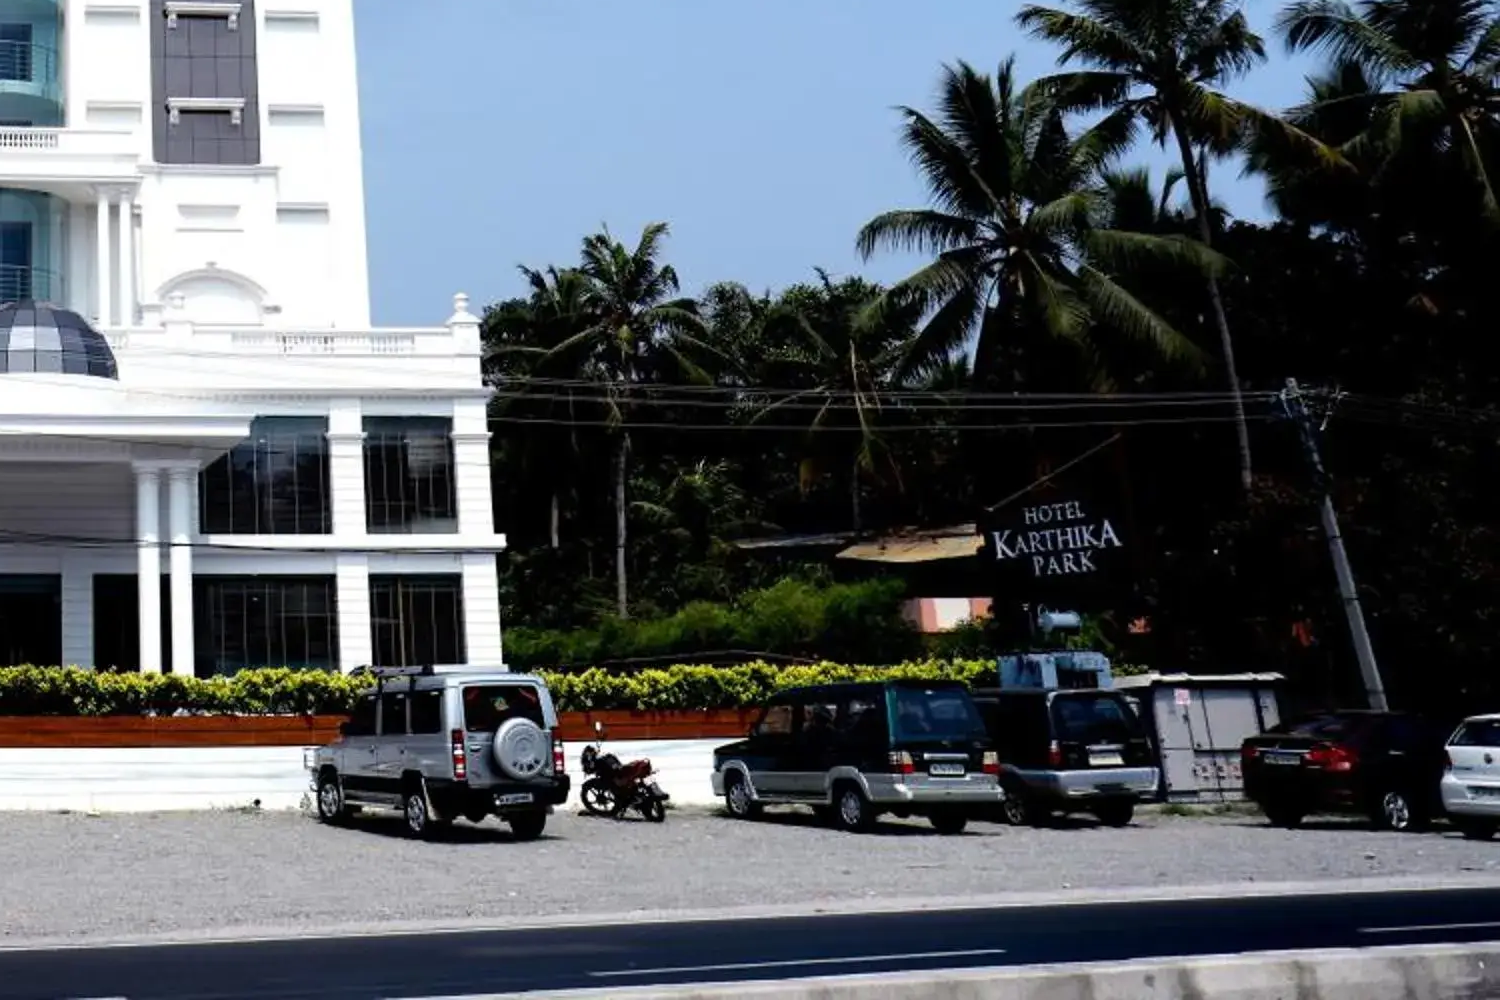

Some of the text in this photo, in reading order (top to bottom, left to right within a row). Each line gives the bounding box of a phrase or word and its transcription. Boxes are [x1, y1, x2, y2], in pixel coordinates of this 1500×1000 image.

[1022, 501, 1086, 525] HOTEL
[991, 519, 1123, 560] KARTHIKA
[1032, 549, 1098, 577] PARK
